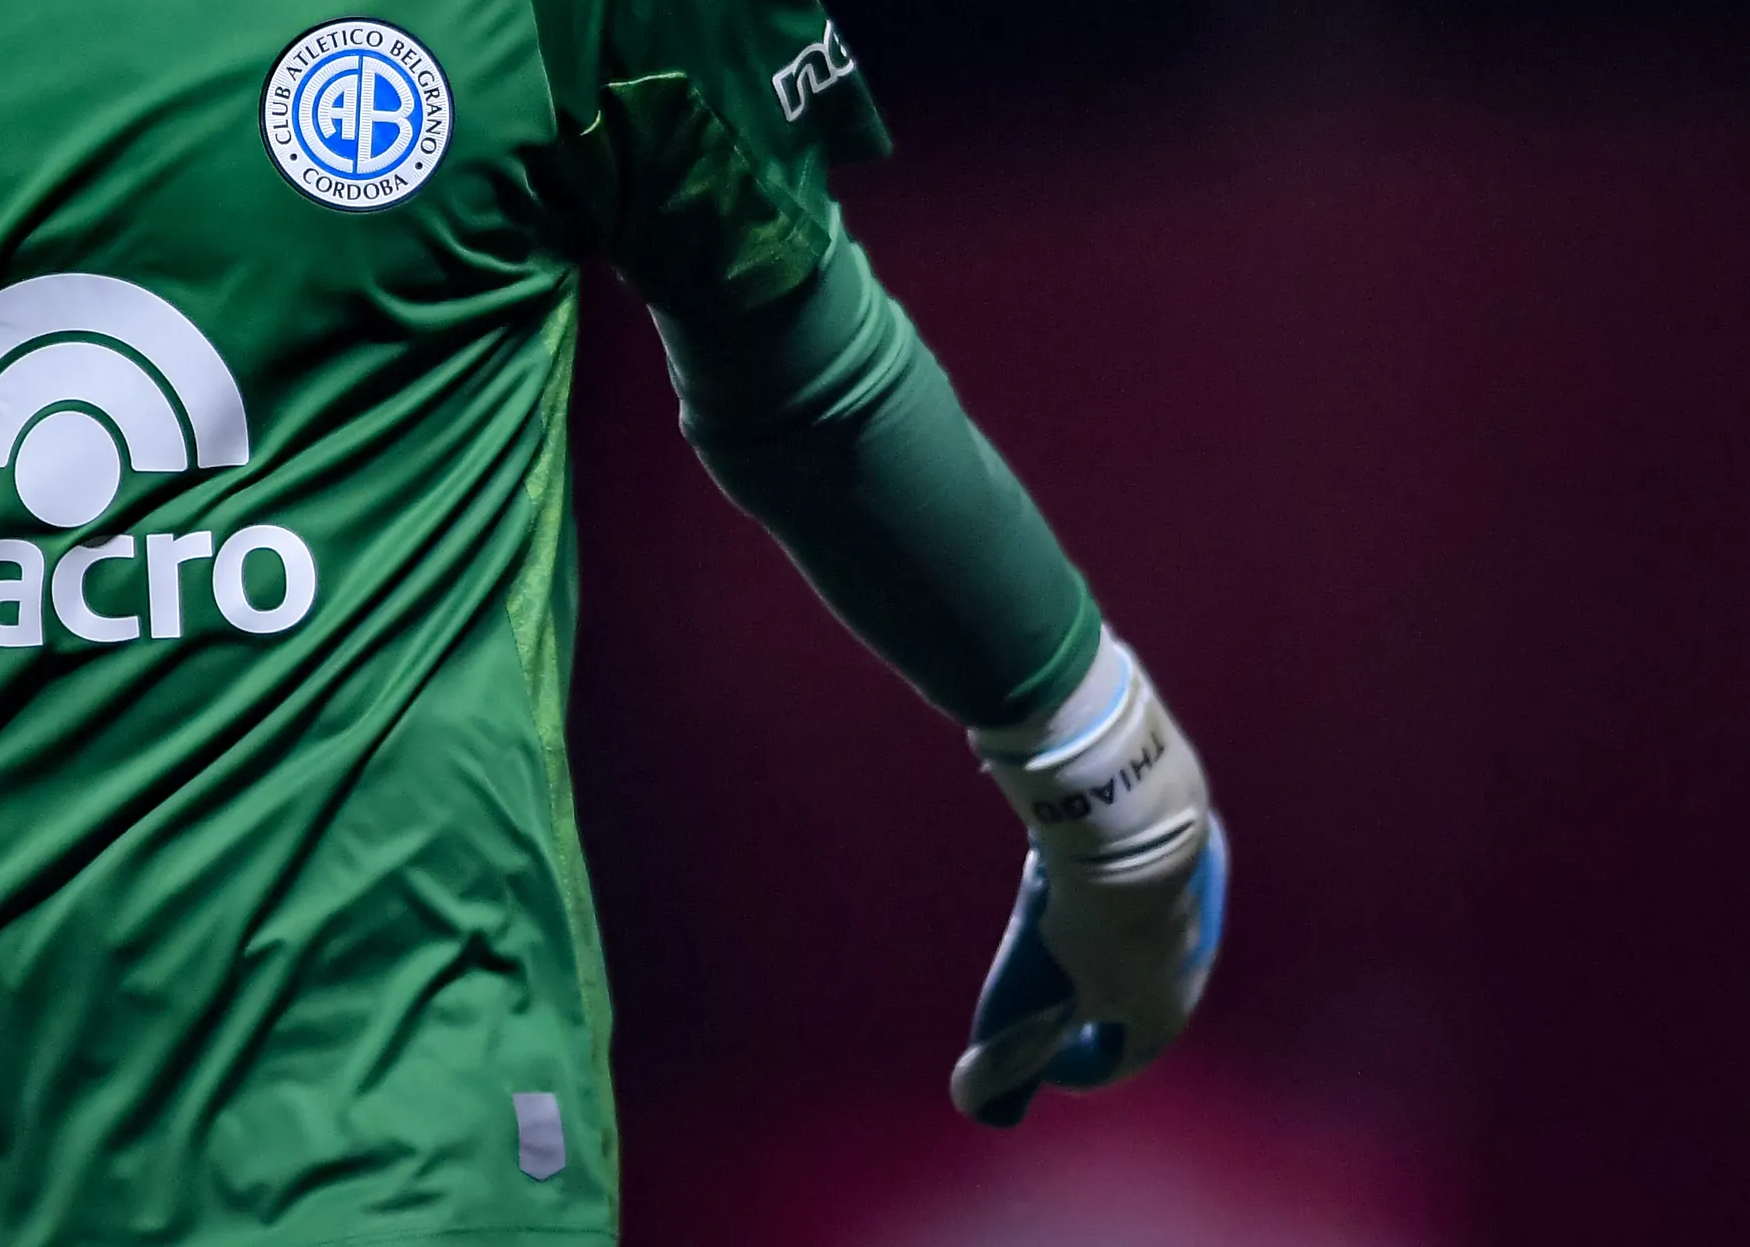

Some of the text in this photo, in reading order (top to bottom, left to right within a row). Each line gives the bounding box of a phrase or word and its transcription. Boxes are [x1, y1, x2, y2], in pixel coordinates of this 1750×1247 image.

[272, 27, 443, 156] CLUB ATLETICO BELGRANO
[303, 167, 409, 201] CORDOBA
[1033, 731, 1166, 825] THIAGO
